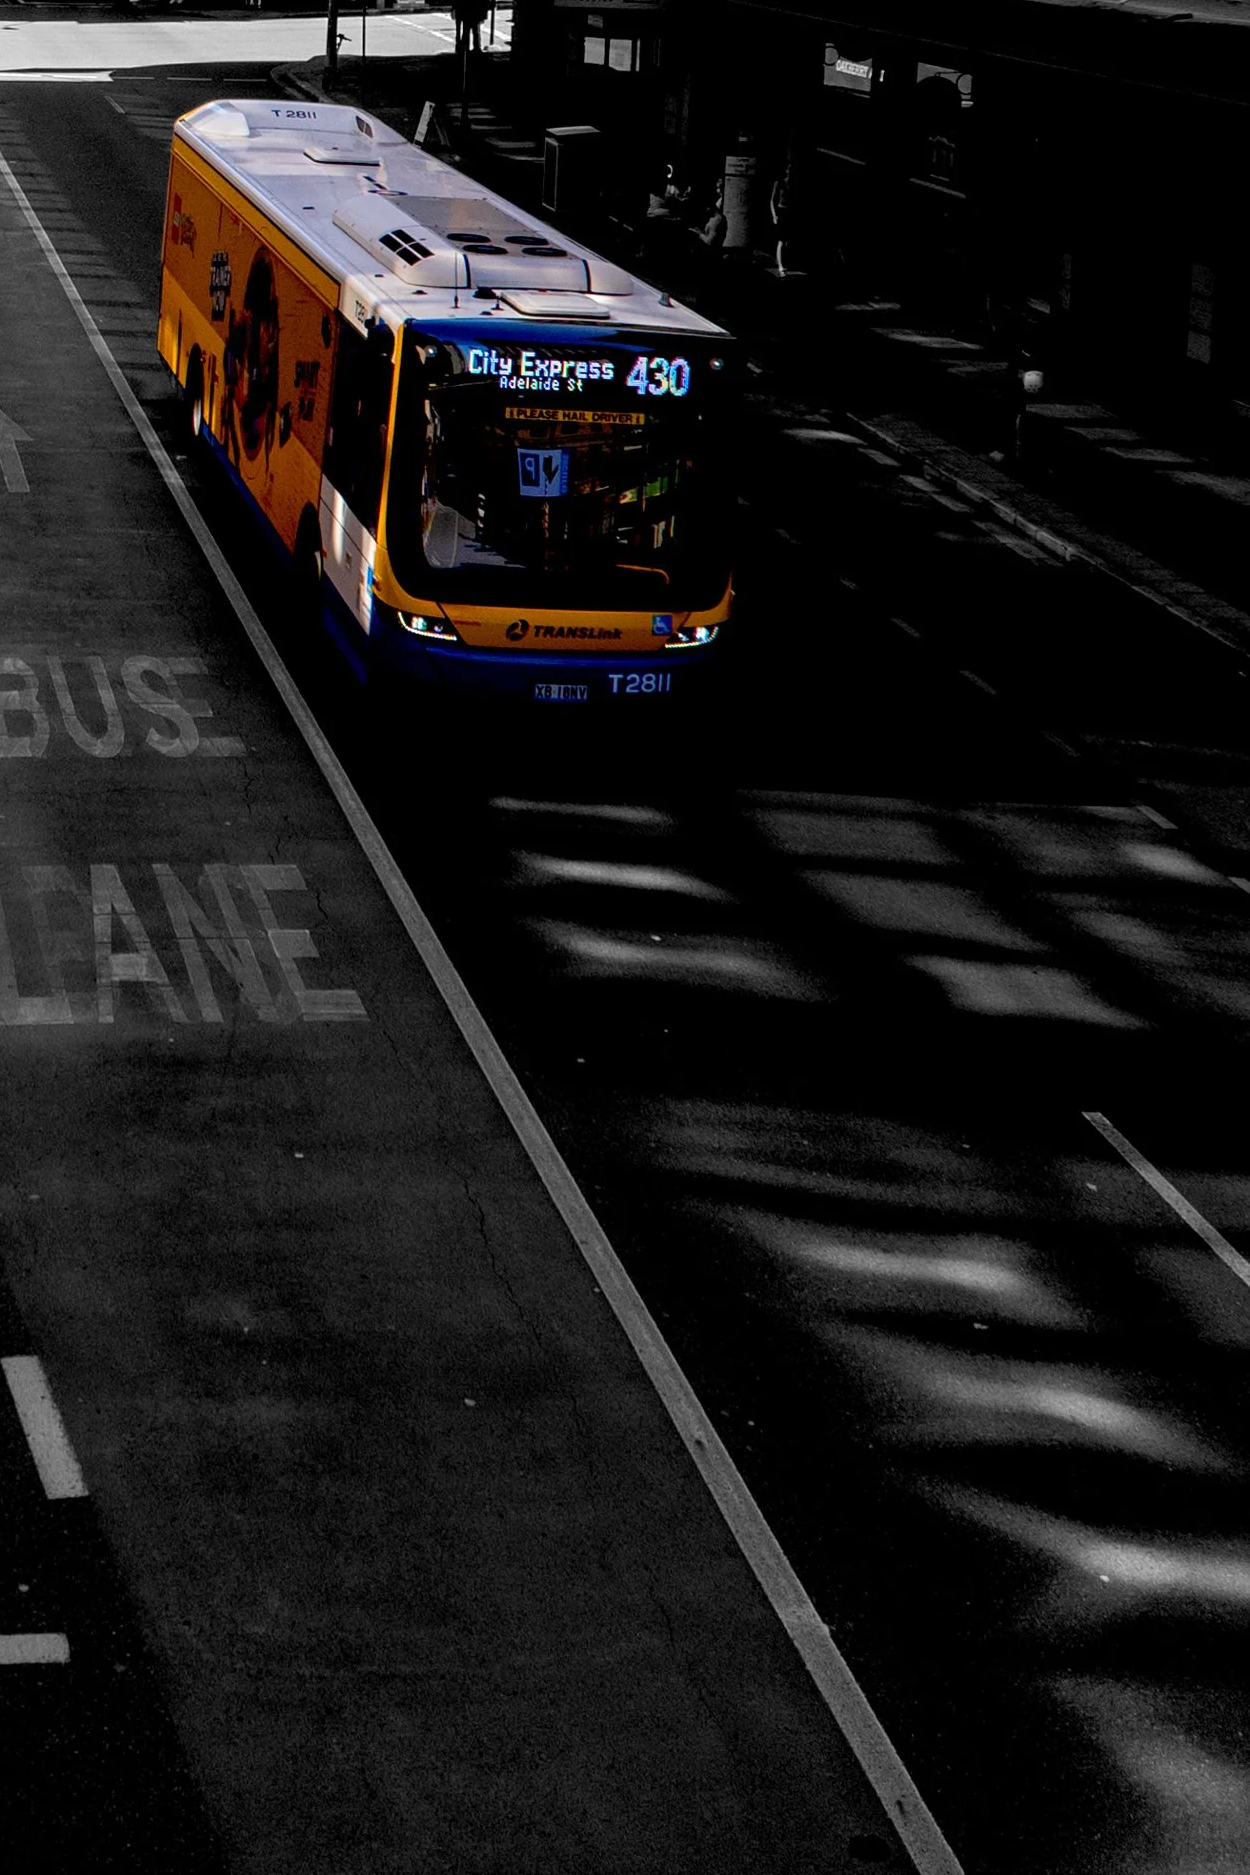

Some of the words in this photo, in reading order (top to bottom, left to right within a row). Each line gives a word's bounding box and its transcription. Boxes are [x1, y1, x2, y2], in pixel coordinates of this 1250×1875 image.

[468, 349, 512, 376] City
[521, 351, 615, 380] Express
[626, 356, 691, 396] 430
[500, 377, 560, 391] Adelaide
[567, 378, 583, 392] St
[516, 408, 558, 420] PLEASE
[562, 410, 588, 422] HAIL
[592, 411, 633, 423] DRIVER
[534, 625, 622, 639] TRANSLink
[608, 672, 672, 694] T2811
